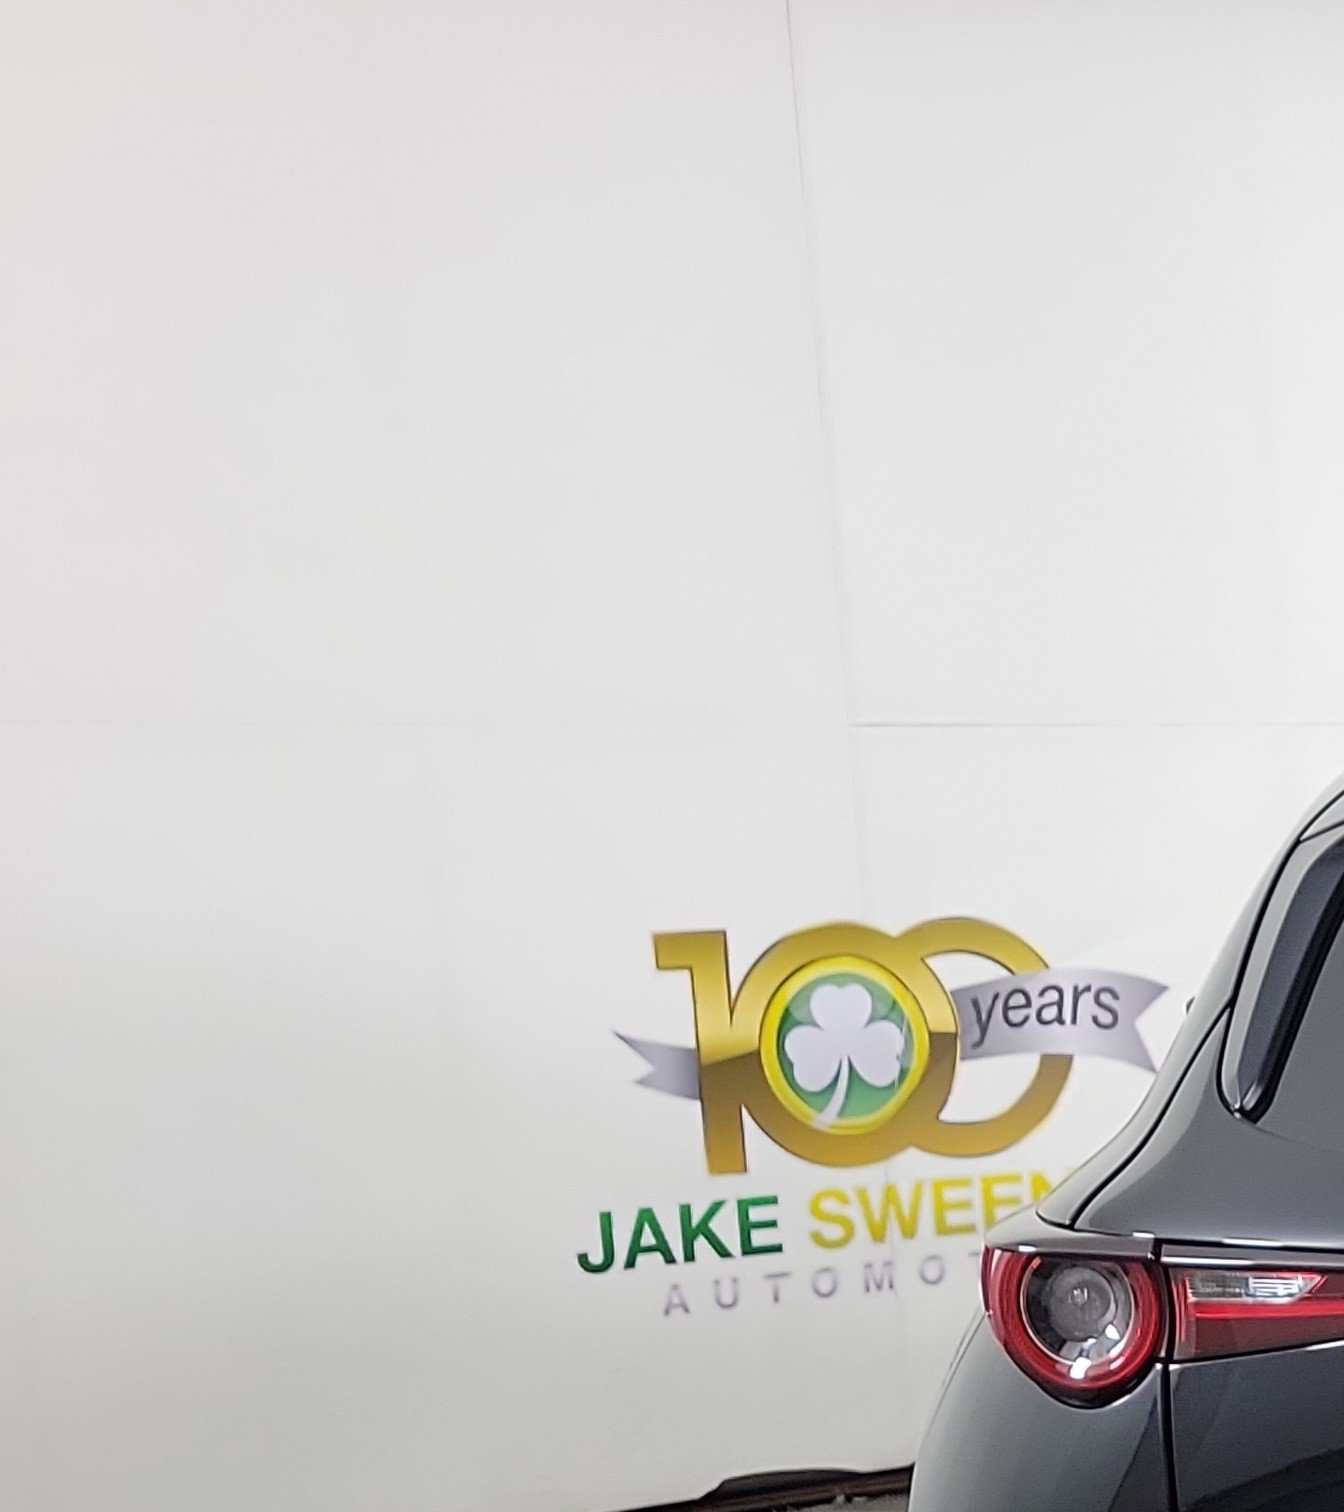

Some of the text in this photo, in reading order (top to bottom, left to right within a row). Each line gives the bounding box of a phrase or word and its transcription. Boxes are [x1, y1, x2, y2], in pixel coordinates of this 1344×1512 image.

[970, 983, 1120, 1049] years
[577, 1195, 784, 1275] JAKE
[663, 1253, 980, 1318] AUTOMO
